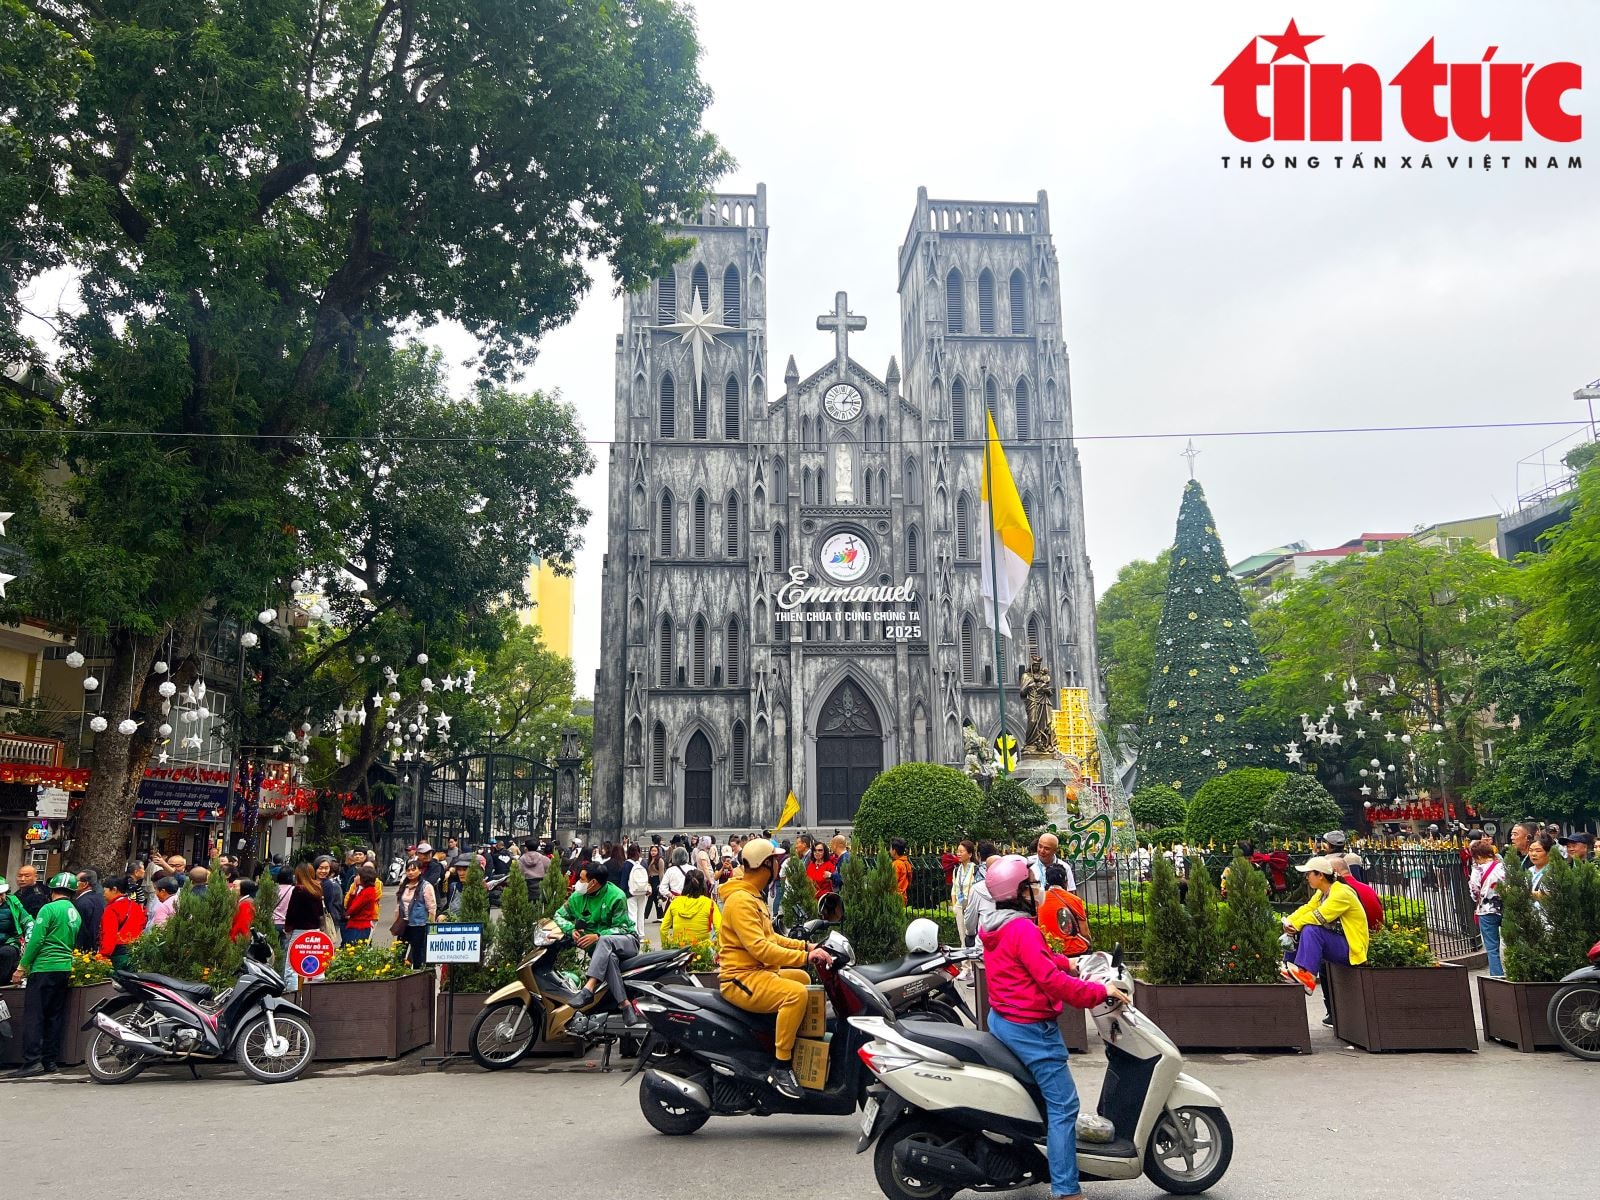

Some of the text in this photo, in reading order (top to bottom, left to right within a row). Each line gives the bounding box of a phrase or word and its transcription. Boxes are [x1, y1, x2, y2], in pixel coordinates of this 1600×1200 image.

[777, 565, 916, 610] Emmanuel
[806, 609, 833, 622] CHÚA
[873, 609, 906, 622] CHÚNG
[909, 611, 920, 621] TA
[886, 626, 922, 638] 2025
[163, 799, 181, 807] COFFEE
[430, 938, 455, 952] KHÔNG
[468, 940, 478, 951] XE
[914, 1072, 953, 1082] LEAD
